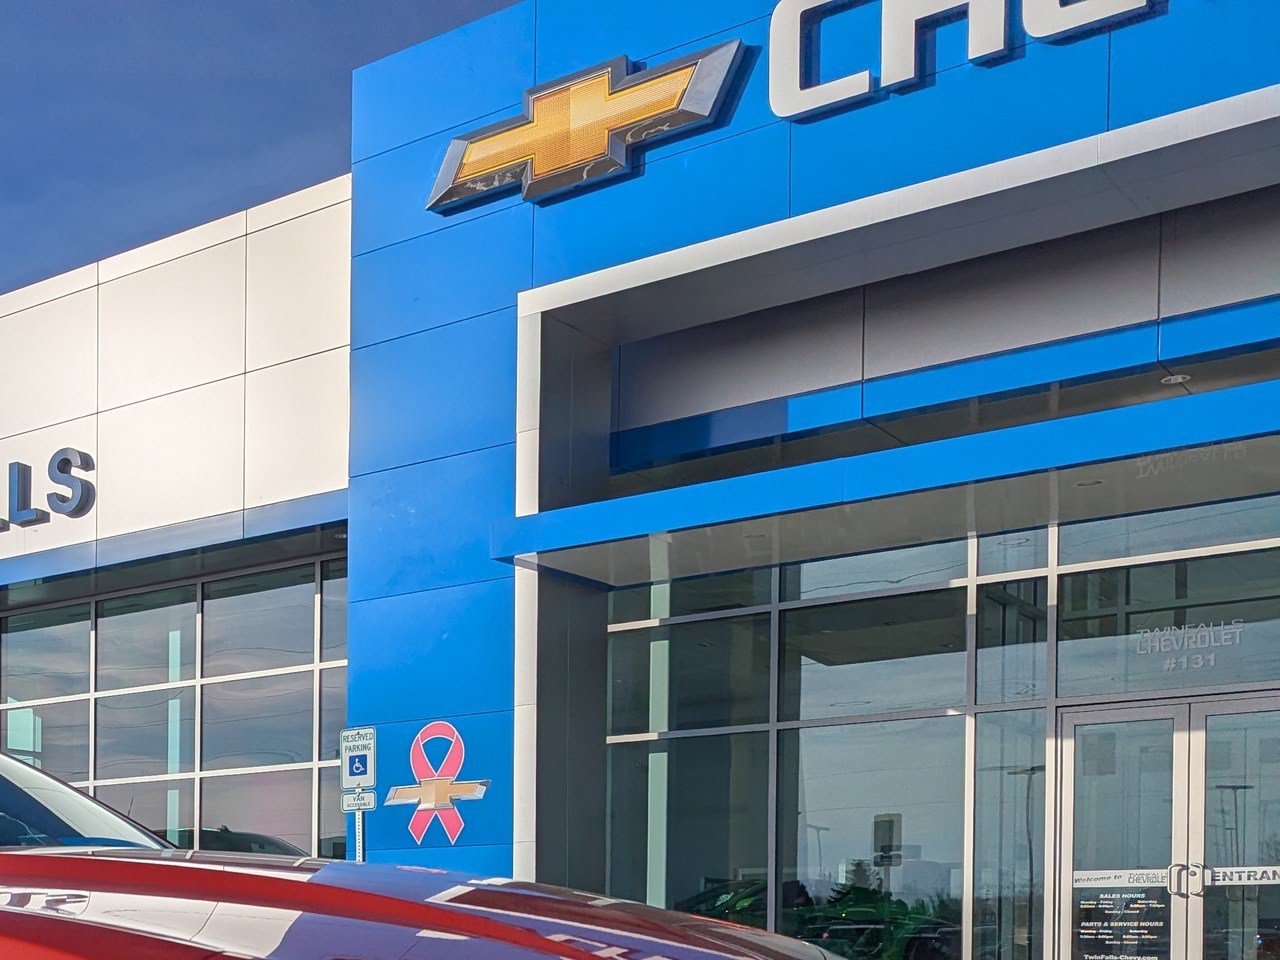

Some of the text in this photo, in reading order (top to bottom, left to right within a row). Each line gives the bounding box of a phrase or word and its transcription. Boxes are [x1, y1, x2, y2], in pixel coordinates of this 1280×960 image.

[1136, 628, 1244, 654] CHEVROLET
[1162, 653, 1217, 672] #131
[342, 732, 374, 743] RESERVED
[344, 743, 372, 753] PARKING
[1074, 875, 1112, 884] Welcome
